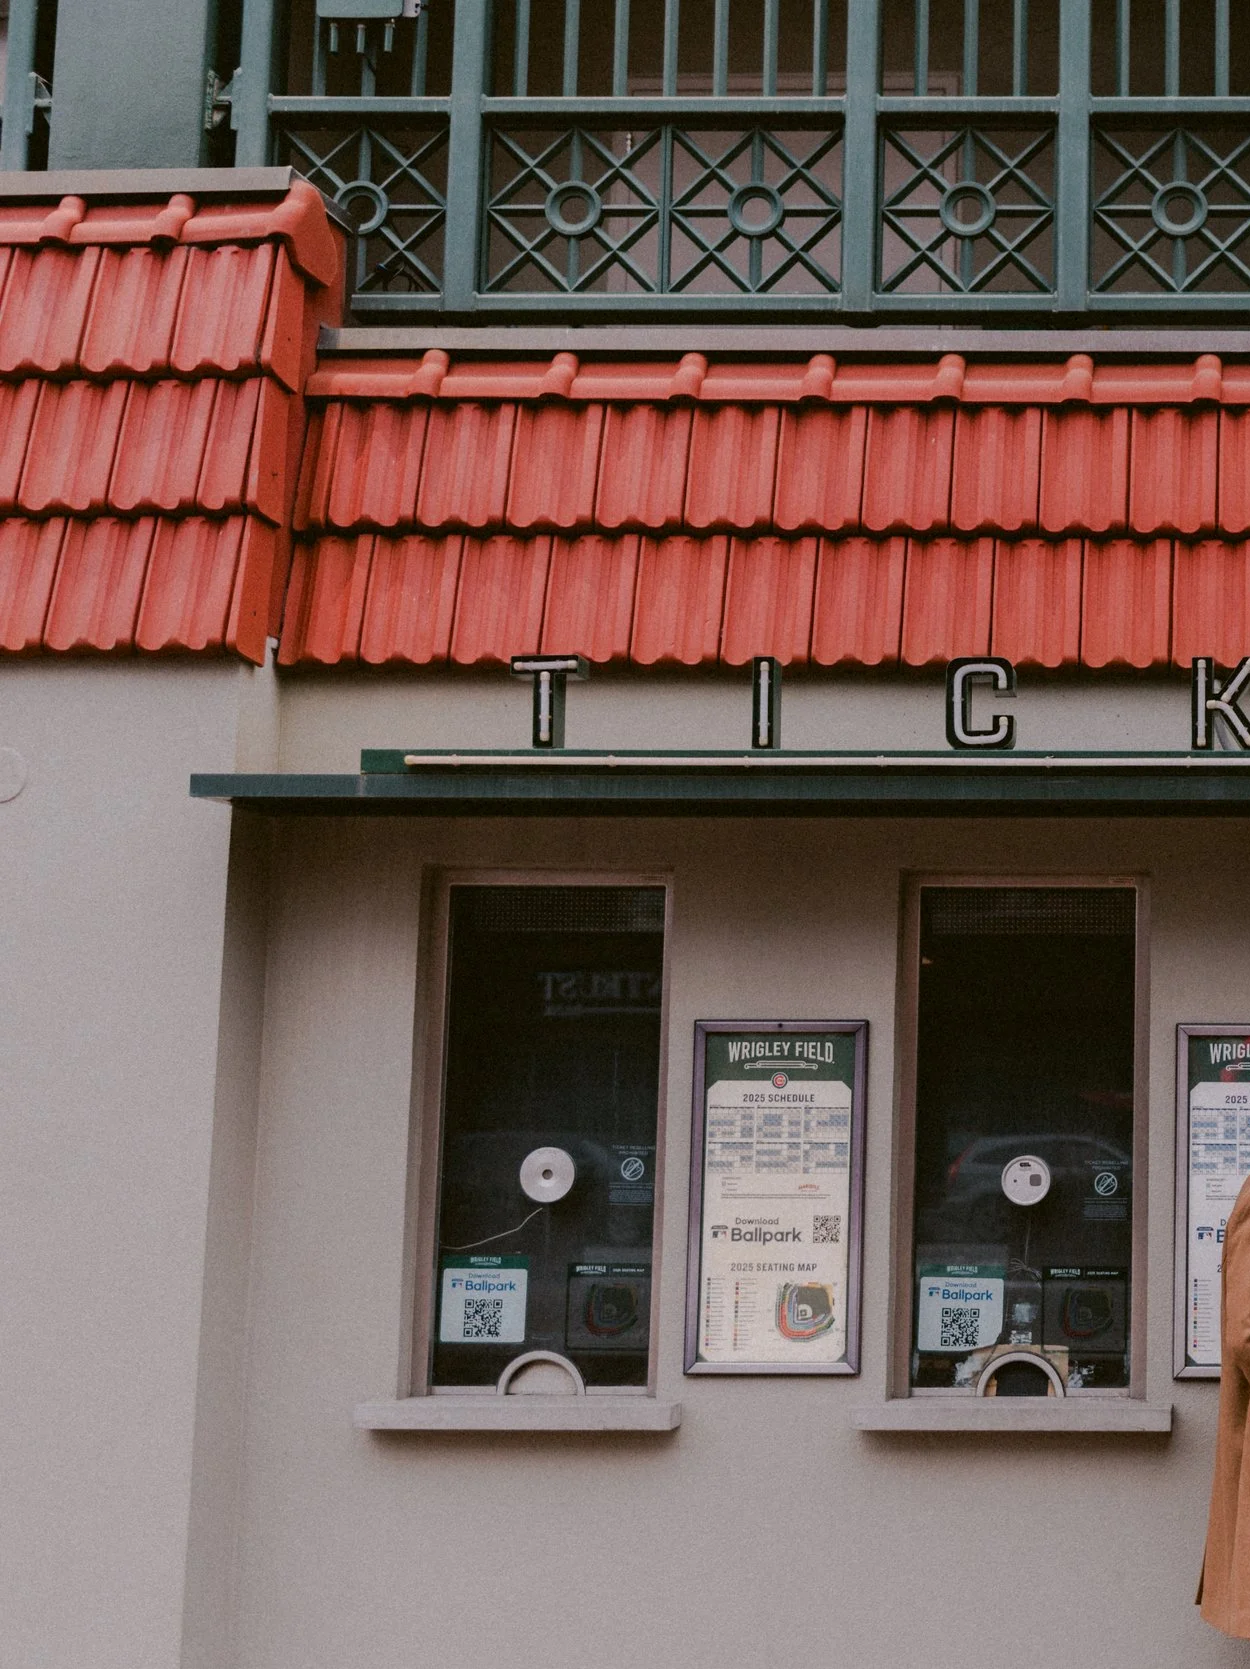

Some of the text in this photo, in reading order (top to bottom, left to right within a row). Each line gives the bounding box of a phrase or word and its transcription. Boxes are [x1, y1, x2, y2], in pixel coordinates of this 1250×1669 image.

[728, 1041, 790, 1063] WRIGLEY
[743, 1094, 815, 1103] 2025 SCHEDULE
[1225, 1095, 1248, 1104] 2025
[735, 1217, 779, 1226] Download
[731, 1227, 802, 1246] Ballpark
[730, 1263, 818, 1272] 2025 SEATING MAP
[465, 1280, 516, 1293] Ballpark
[942, 1289, 993, 1302] Ballpark
